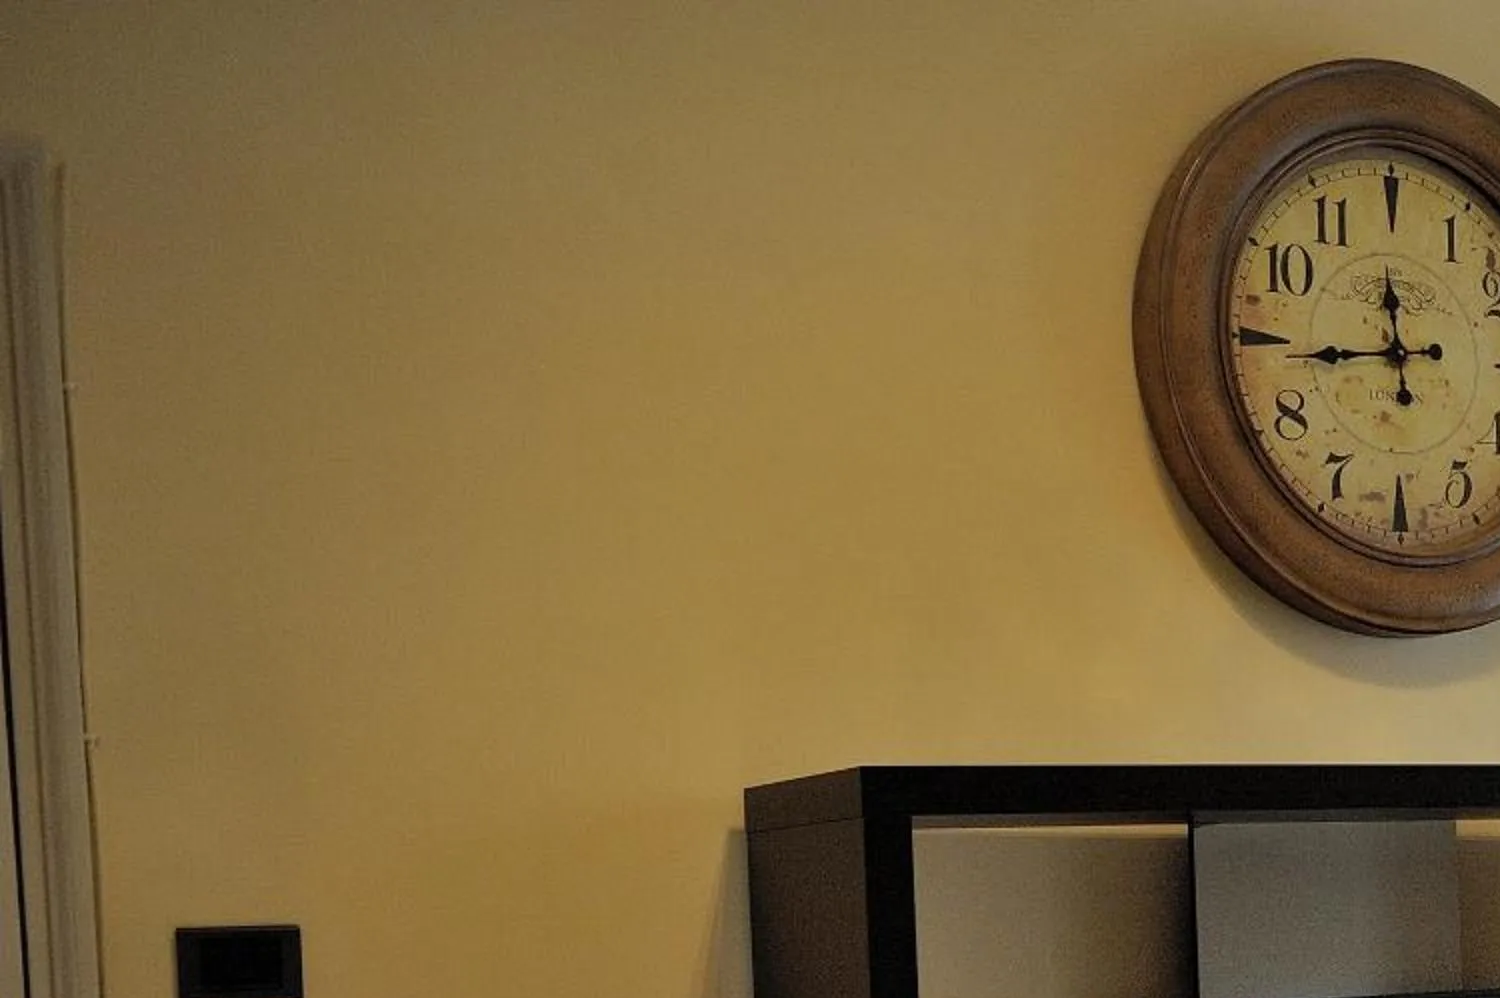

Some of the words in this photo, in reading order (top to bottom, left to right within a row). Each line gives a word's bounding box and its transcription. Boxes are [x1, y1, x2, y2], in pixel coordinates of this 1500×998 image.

[1313, 195, 1348, 247] 11
[1442, 214, 1462, 264] 1
[1265, 243, 1314, 297] 10
[1274, 389, 1309, 441] 8
[1368, 389, 1425, 405] LONN
[1325, 452, 1354, 500] 7
[1444, 460, 1473, 509] 5
